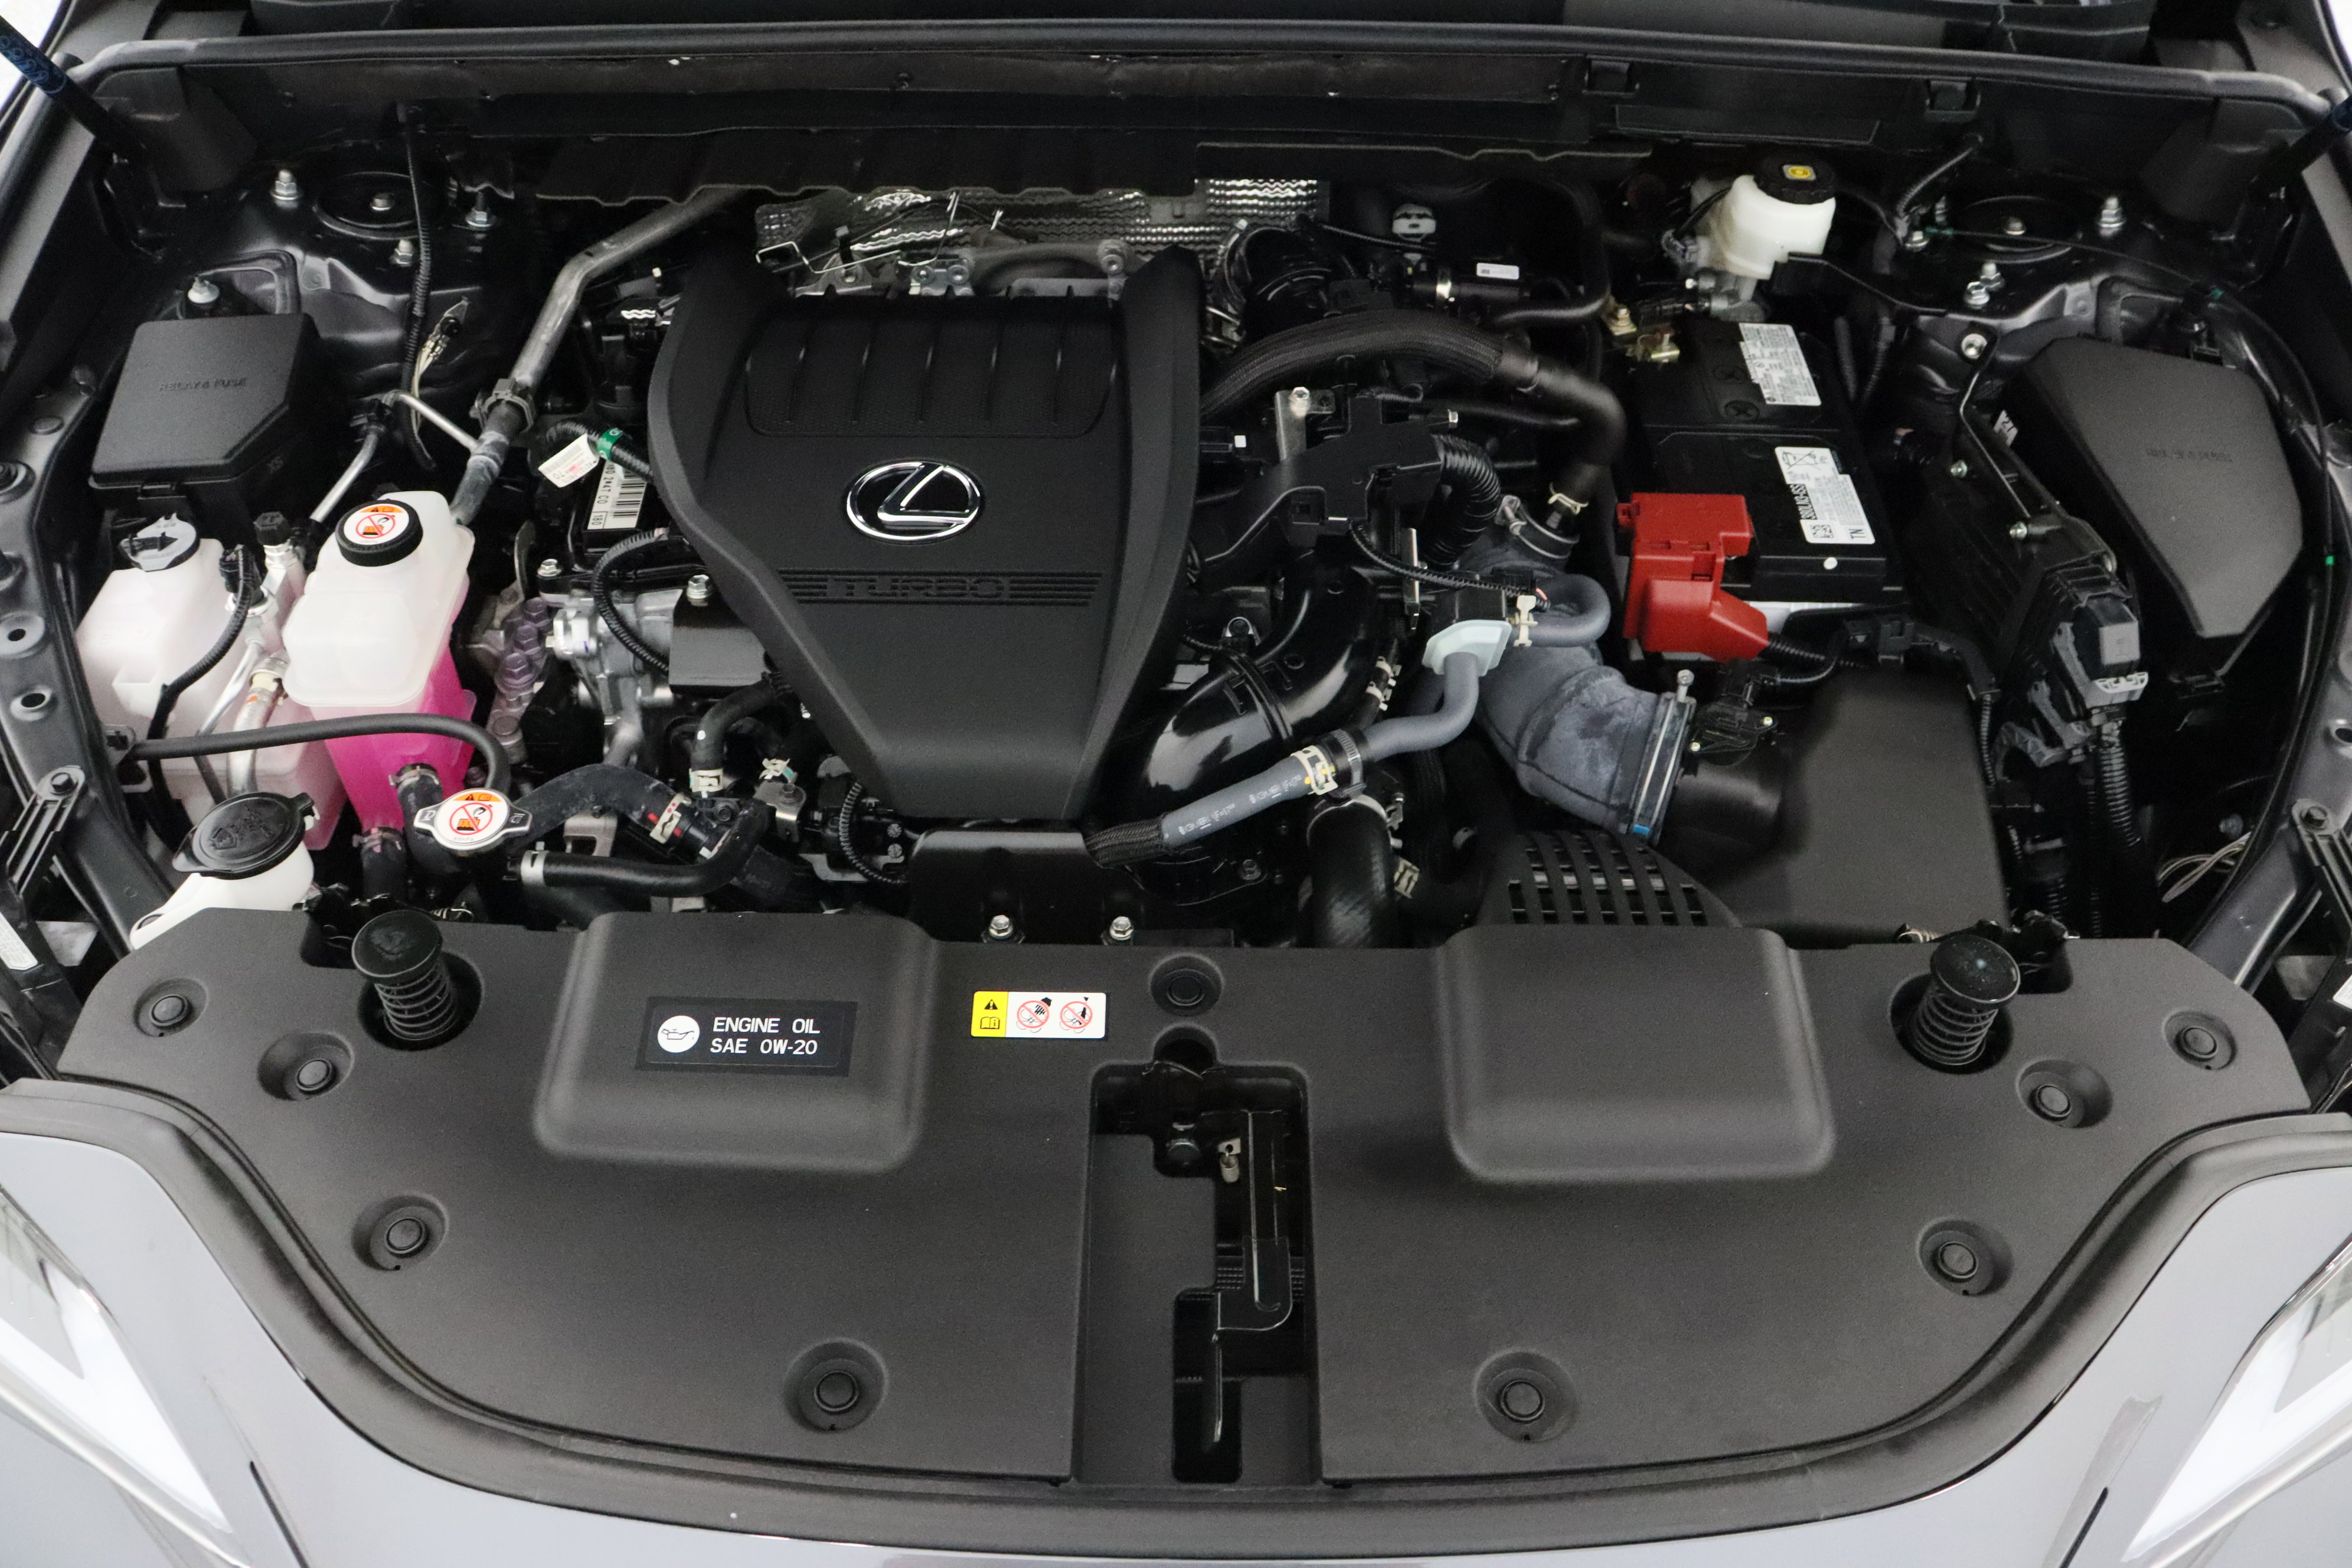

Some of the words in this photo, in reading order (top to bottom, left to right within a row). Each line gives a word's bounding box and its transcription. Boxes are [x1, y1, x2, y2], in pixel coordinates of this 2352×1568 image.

[834, 576, 1005, 599] TURBO
[713, 1017, 780, 1033] ENGINE
[792, 1018, 821, 1034] OIL
[710, 1038, 749, 1054] SAE
[760, 1038, 818, 1055] 0W-20
